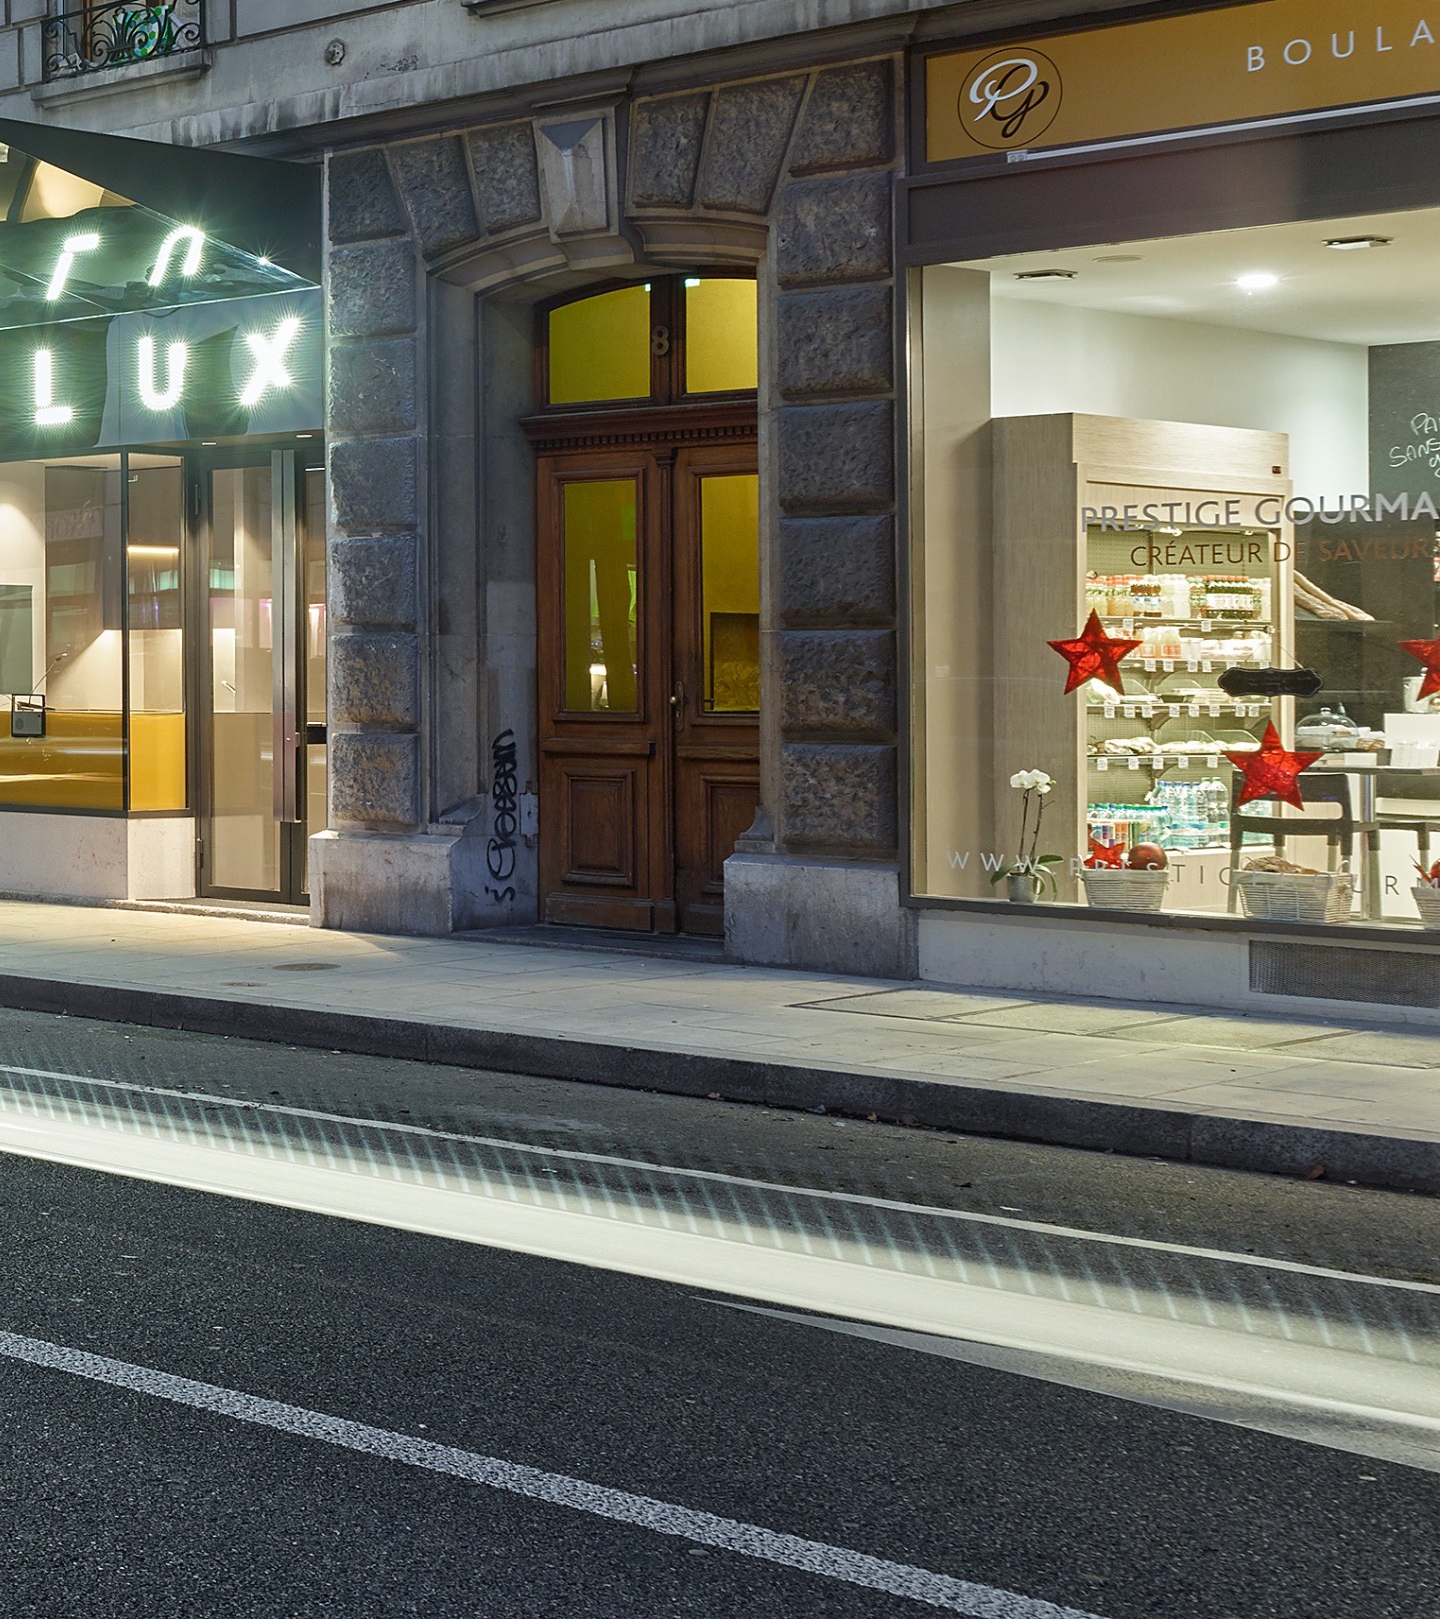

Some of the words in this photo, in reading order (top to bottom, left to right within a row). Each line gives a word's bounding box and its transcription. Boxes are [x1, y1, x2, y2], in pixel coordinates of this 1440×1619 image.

[1247, 19, 1435, 72] BOULA
[652, 325, 670, 356] 8
[1410, 413, 1440, 435] PA
[1080, 499, 1242, 533] PRESTIGE
[1254, 491, 1439, 525] GOURMA
[1130, 539, 1264, 567] CRÉATEUR
[1273, 540, 1307, 564] DE
